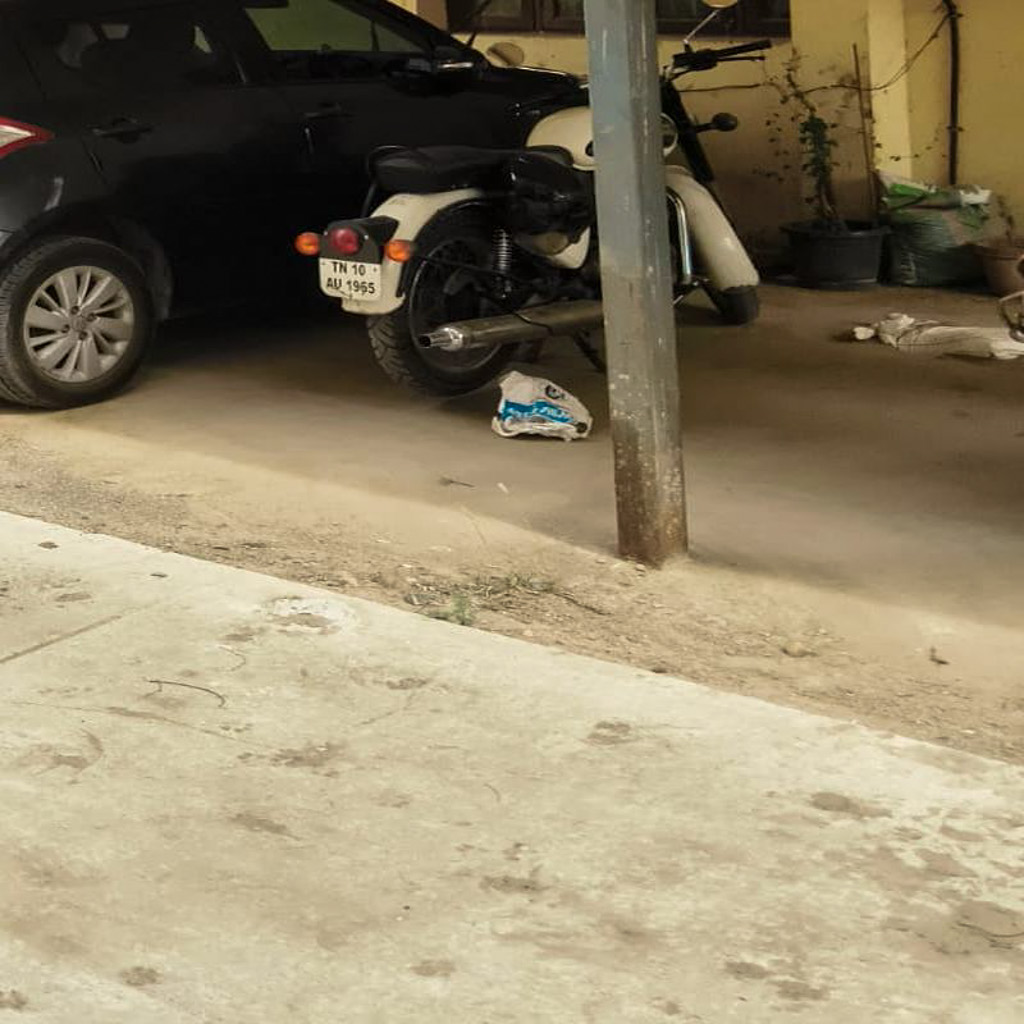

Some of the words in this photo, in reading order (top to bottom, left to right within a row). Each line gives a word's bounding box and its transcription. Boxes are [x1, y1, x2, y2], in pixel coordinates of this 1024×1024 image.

[332, 262, 347, 273] TN
[351, 264, 366, 275] 10
[327, 278, 342, 289] AU
